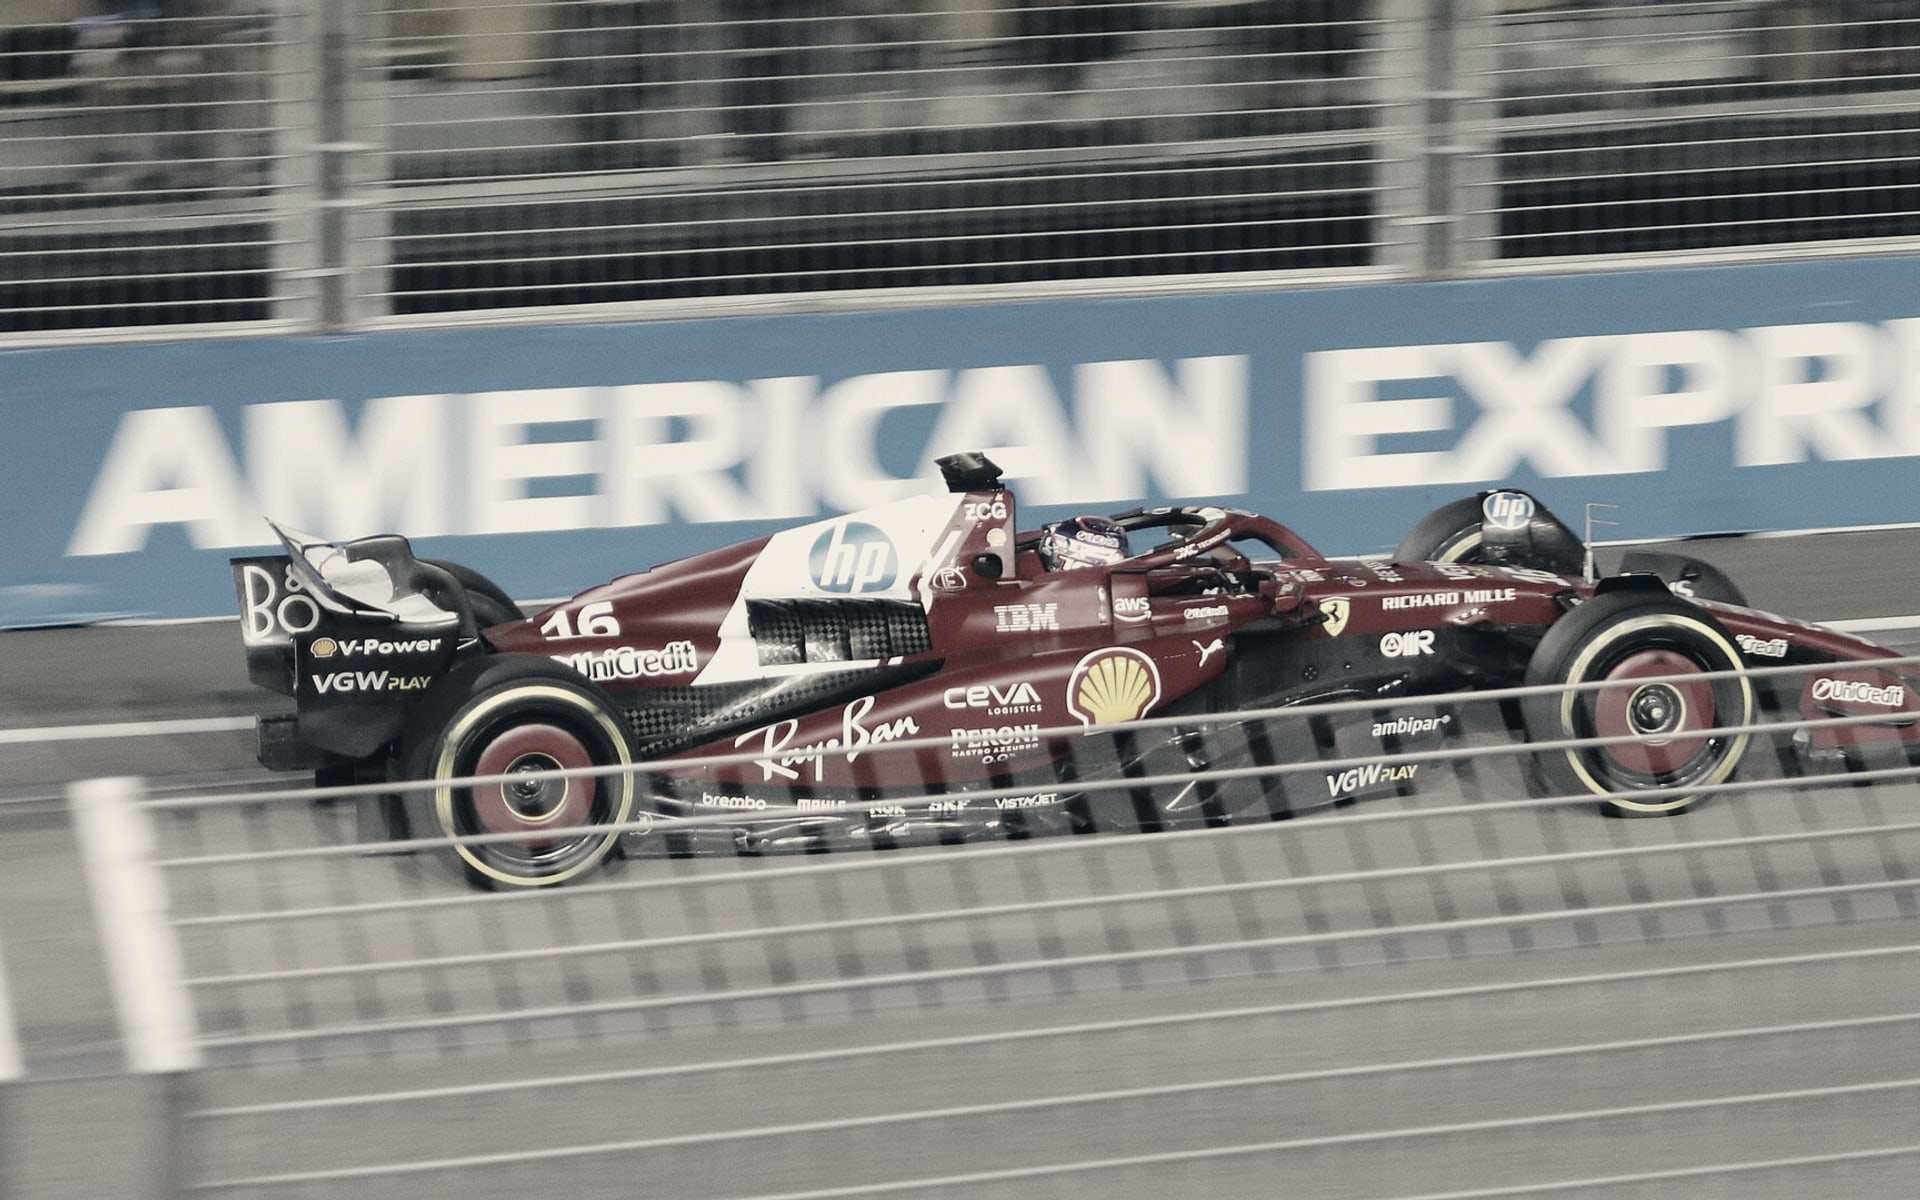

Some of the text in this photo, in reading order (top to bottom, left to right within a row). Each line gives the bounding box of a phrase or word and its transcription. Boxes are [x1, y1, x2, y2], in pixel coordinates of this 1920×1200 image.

[64, 316, 1920, 556] AMERICAN EXPR
[964, 502, 1007, 520] ZCG
[1493, 493, 1526, 529] hp
[820, 522, 890, 592] hp
[1114, 597, 1150, 612] aws
[1382, 588, 1517, 611] RICHARD MILLE
[540, 601, 620, 641] 16
[994, 603, 1060, 632] IBM
[338, 637, 442, 656] V-Power
[1736, 634, 1788, 658] Credit
[573, 641, 696, 681] UniCredit
[311, 670, 432, 694] VGW PLAY
[1832, 681, 1904, 706] UniCredit
[988, 704, 1042, 716] LOGISTICS
[951, 724, 1039, 749] PERONI
[1372, 716, 1441, 737] ambipar
[1326, 764, 1418, 797] VGW PLAY
[702, 792, 767, 810] brembo
